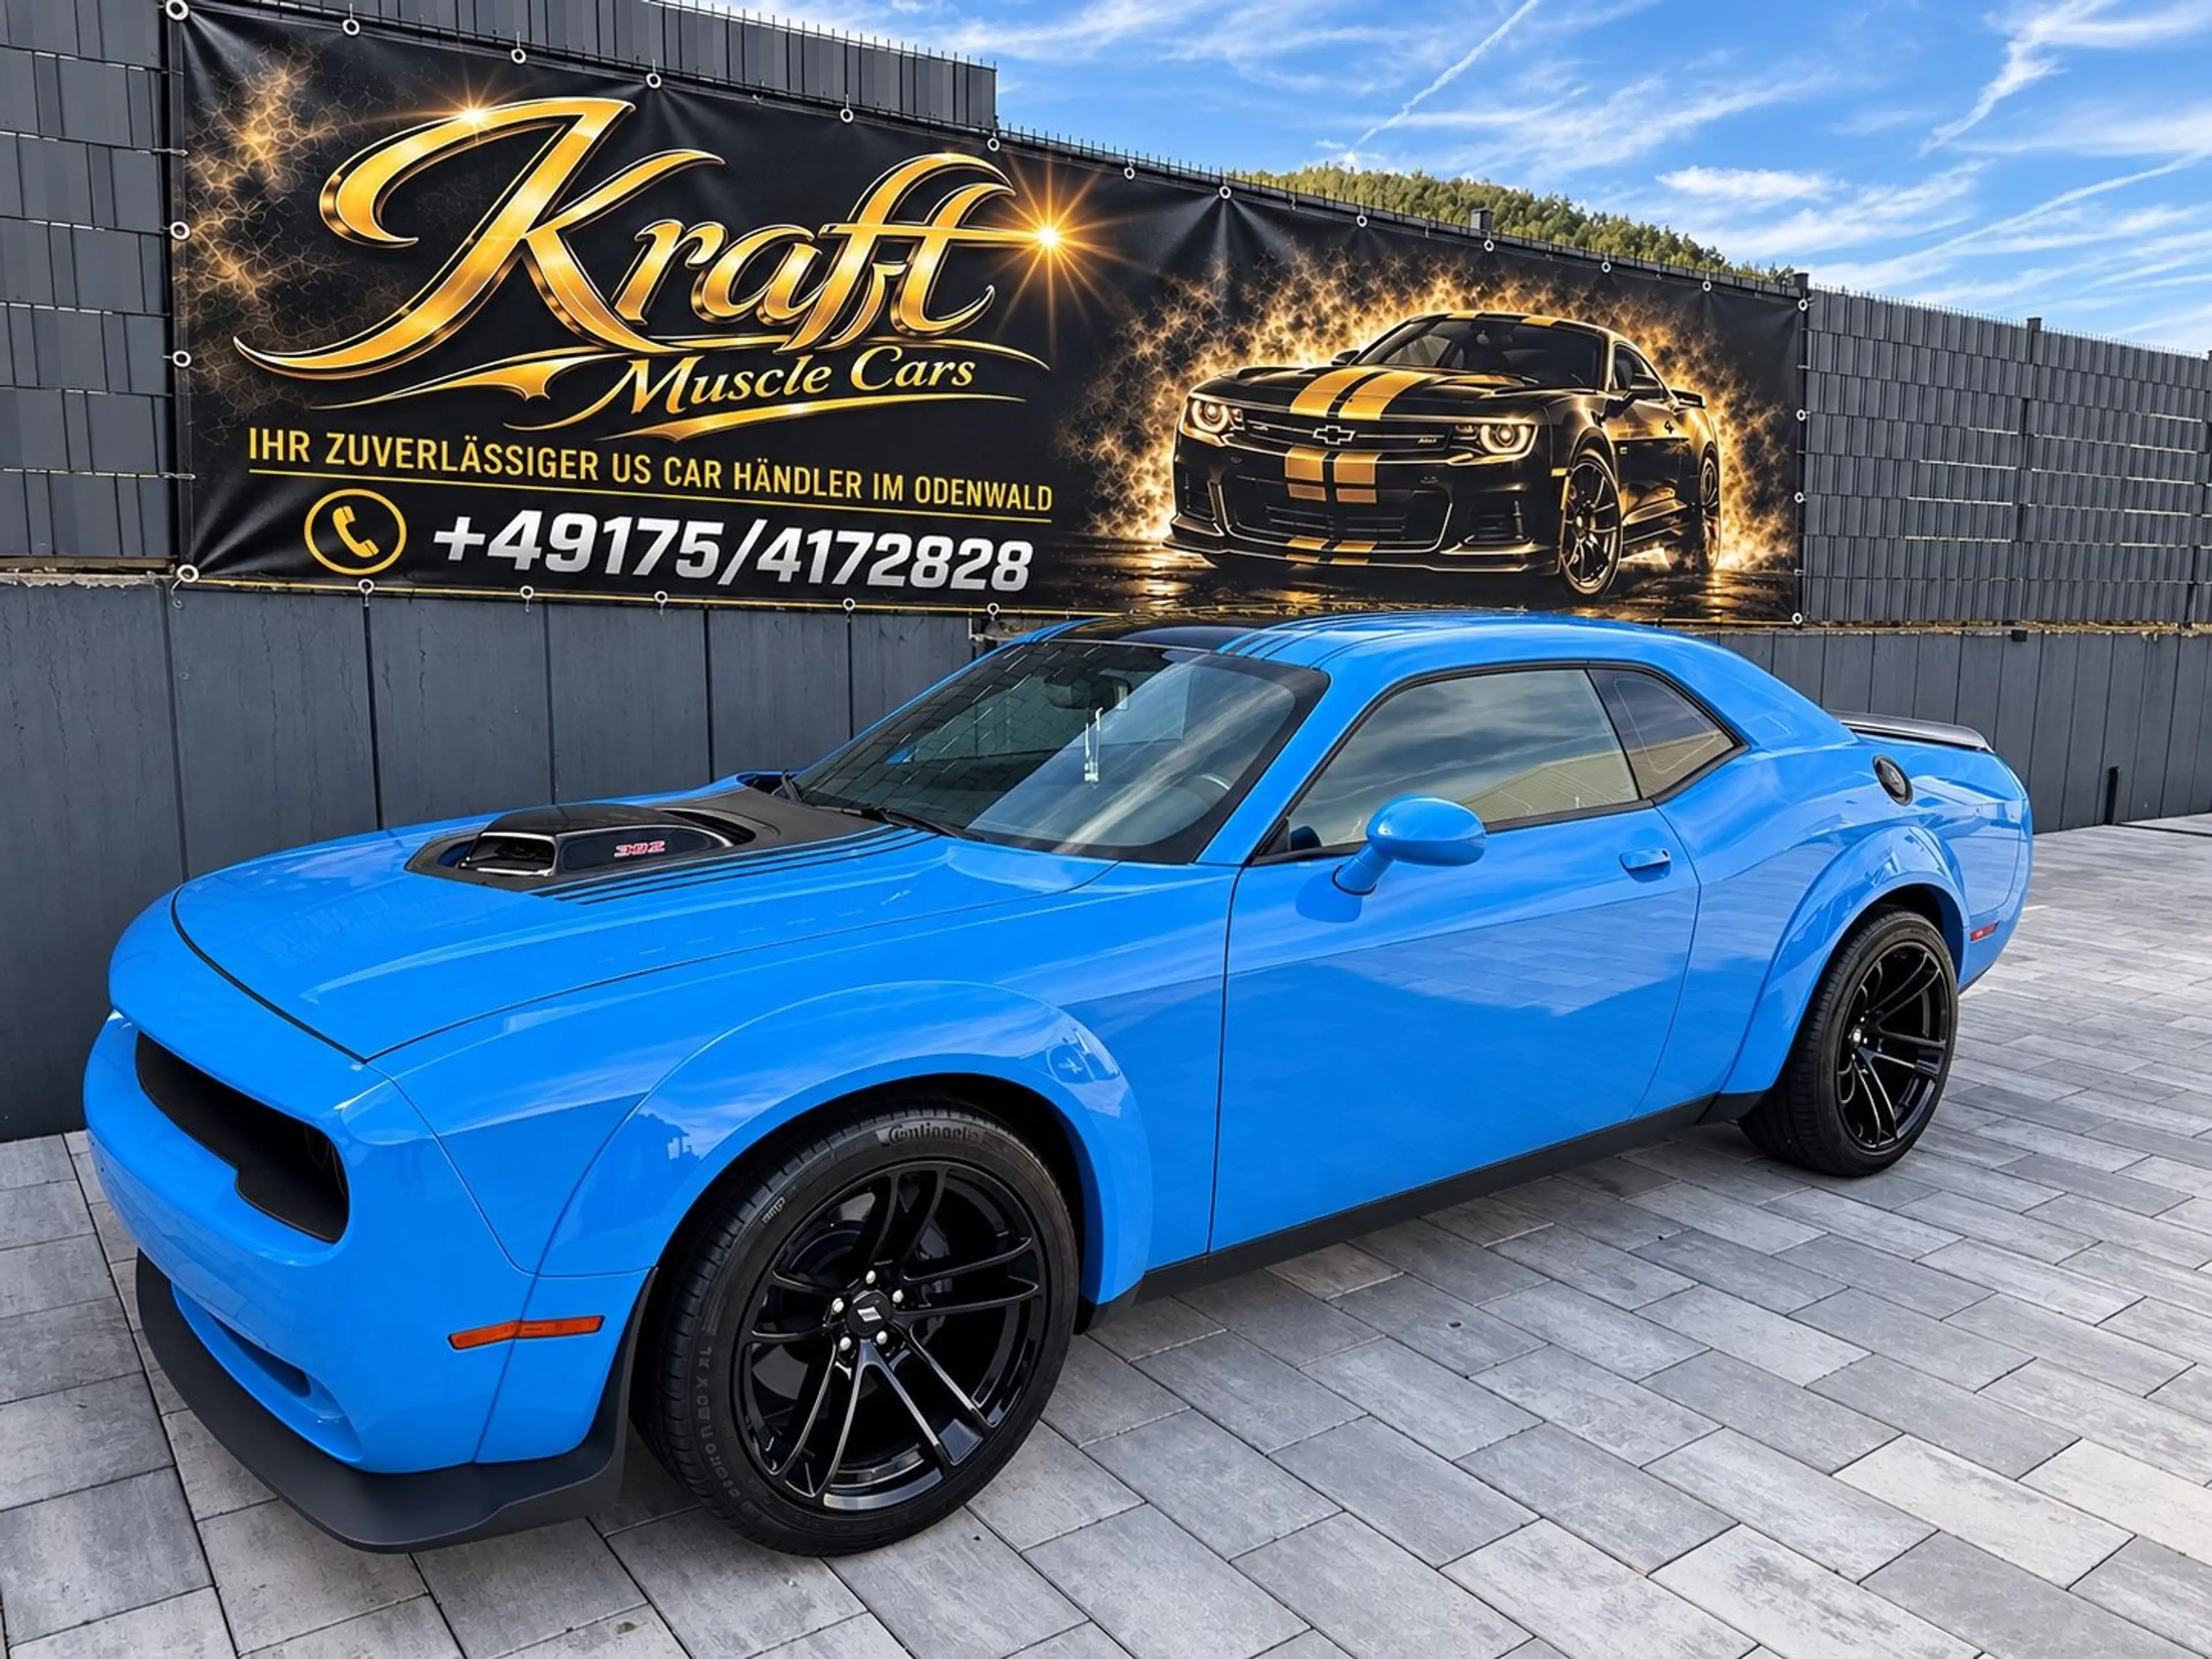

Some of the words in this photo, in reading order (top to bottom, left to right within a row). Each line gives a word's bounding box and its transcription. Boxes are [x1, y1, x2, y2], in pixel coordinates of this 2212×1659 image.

[233, 96, 1015, 380] Kraft
[582, 355, 833, 425] Muscle
[850, 347, 977, 394] Cars
[248, 427, 310, 463] IHR
[325, 431, 600, 480] ZUVERLÄSSIGER
[612, 453, 652, 486] US
[662, 457, 721, 490] CAR
[733, 459, 864, 501] HÄNDLER
[872, 473, 905, 503] IM
[914, 476, 1054, 513] ODENWALD
[433, 510, 1034, 591] +49175/4172828
